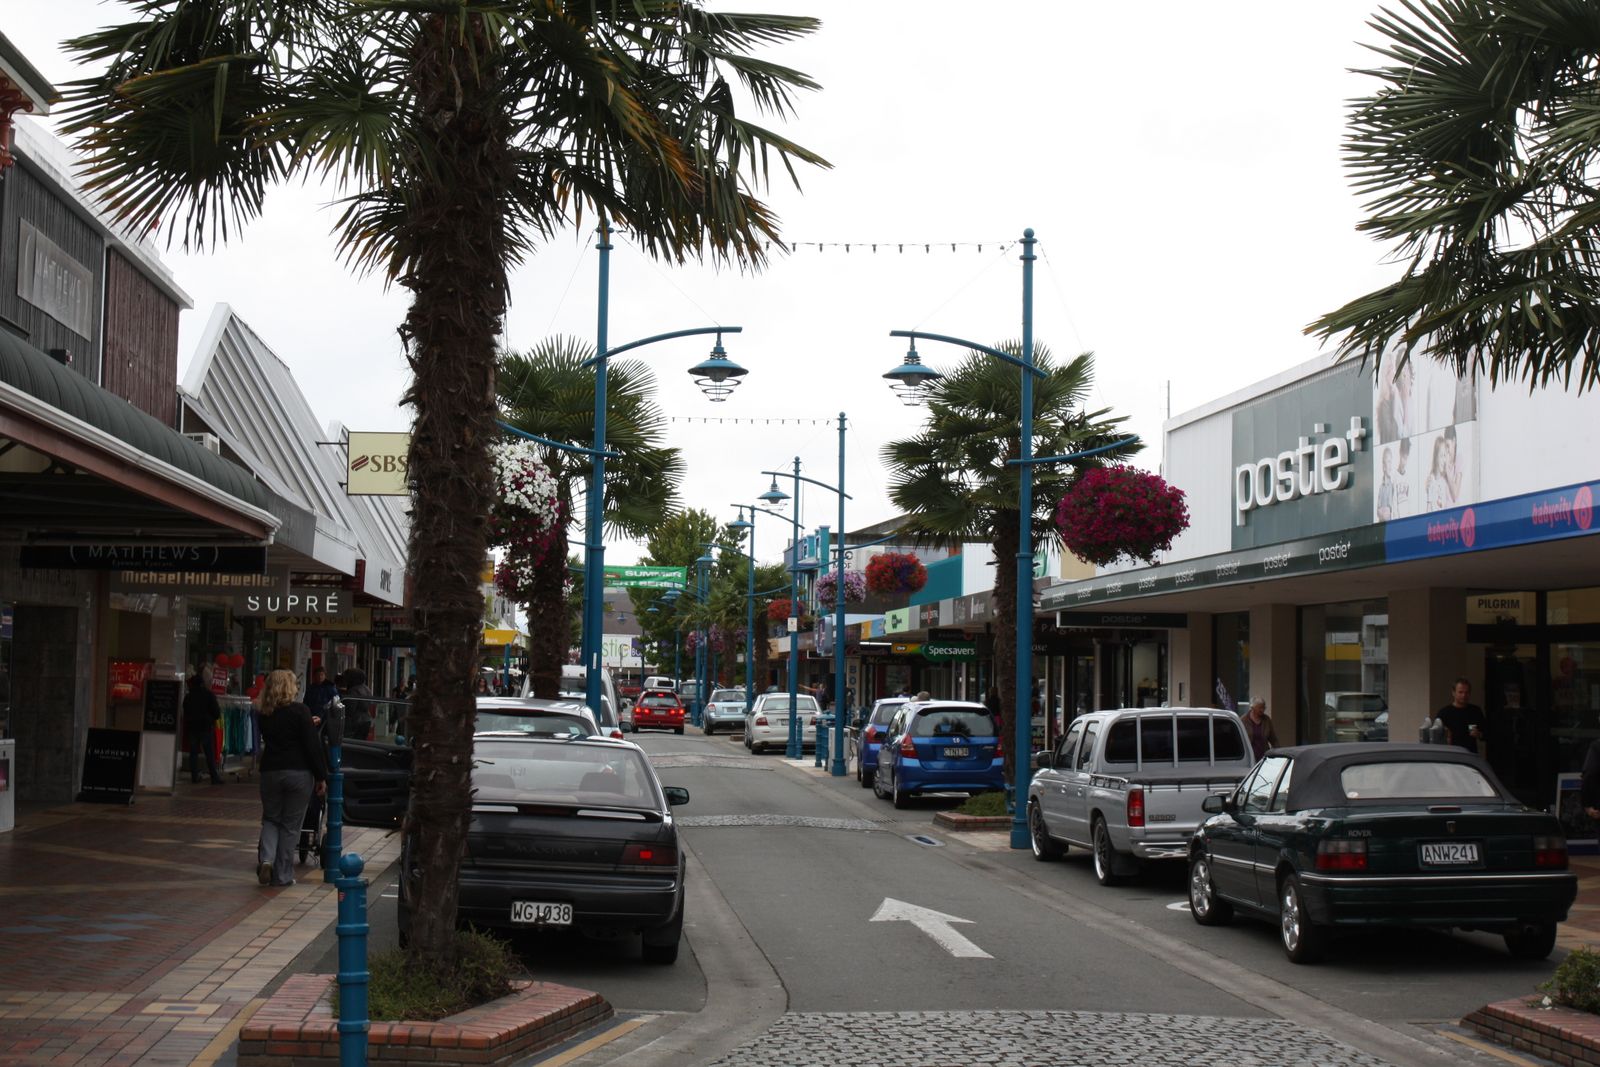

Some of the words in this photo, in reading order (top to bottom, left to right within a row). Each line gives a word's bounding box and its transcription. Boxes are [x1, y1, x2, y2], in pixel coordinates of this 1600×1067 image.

[370, 454, 408, 473] SBS
[121, 570, 181, 584] Michael
[184, 571, 210, 585] Hill
[212, 572, 279, 587] Jeweller
[625, 570, 682, 578] SUMMER
[248, 592, 338, 613] SUPRÉ
[1478, 599, 1520, 609] PILGRIM
[928, 645, 975, 656] Specsavers
[1348, 829, 1372, 837] ROVER
[1424, 844, 1476, 861] ANW241
